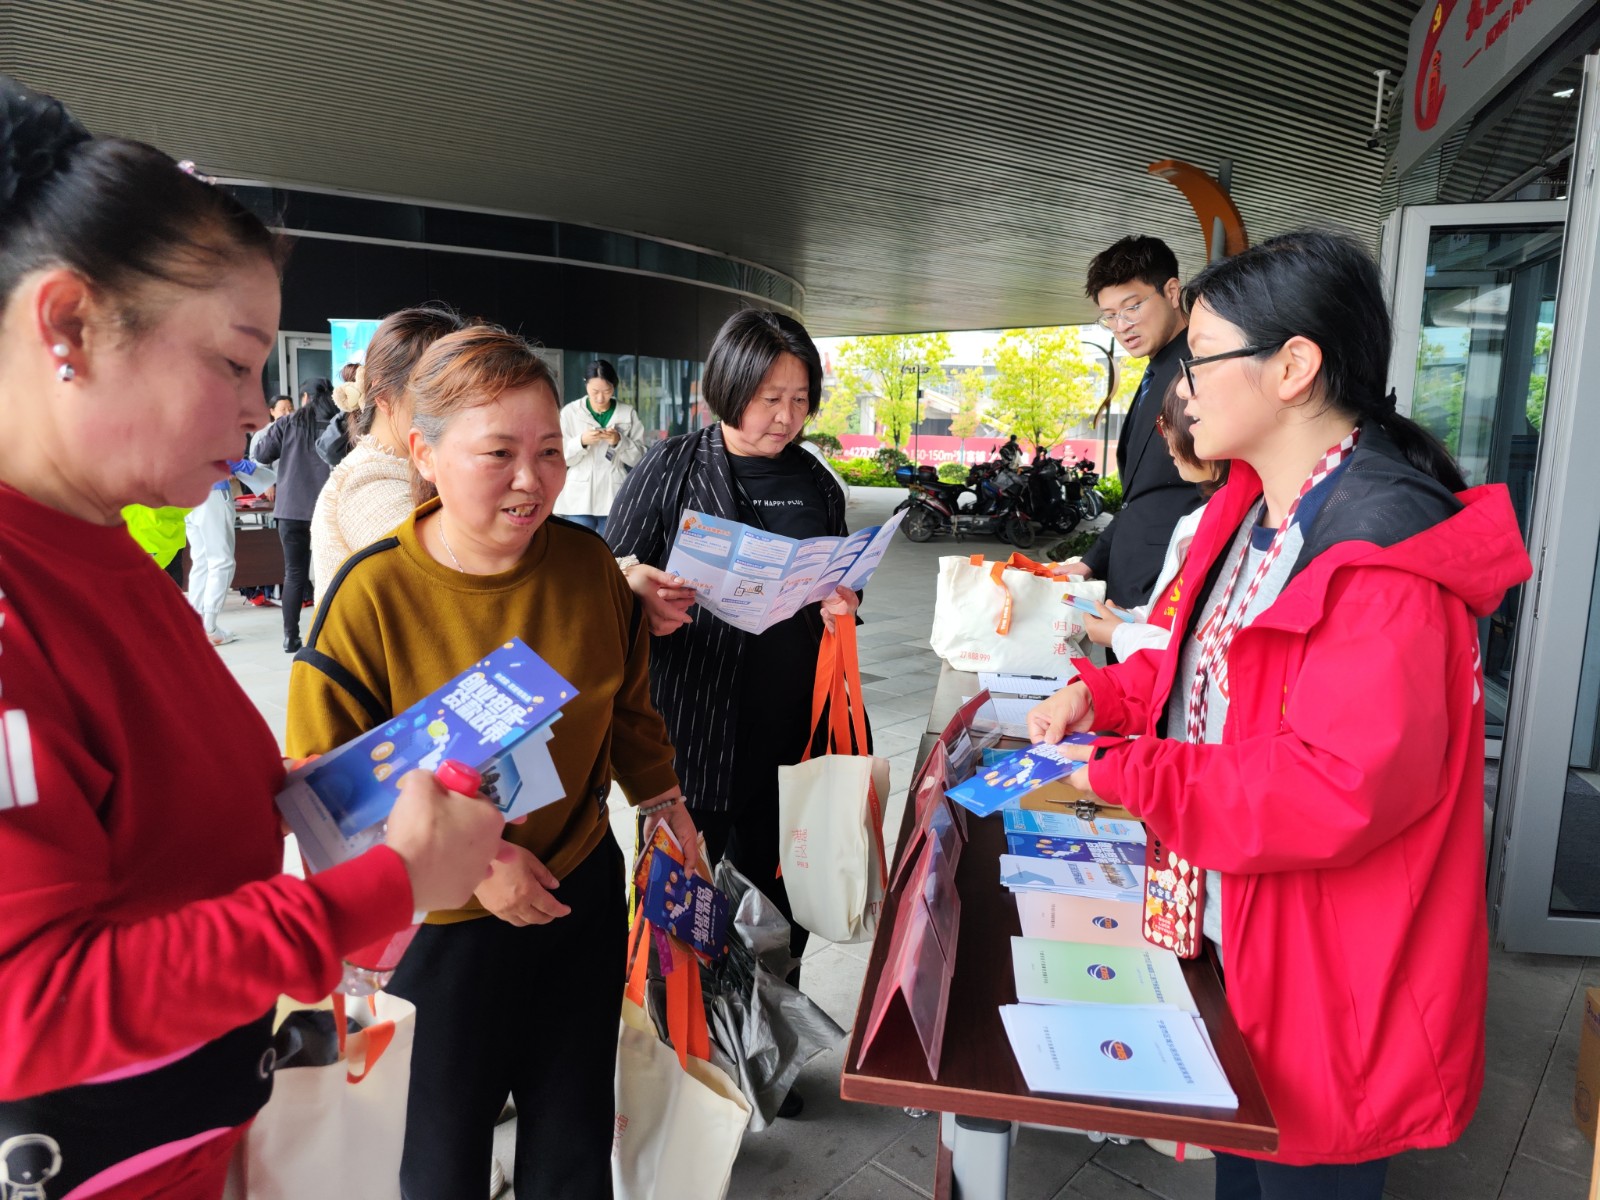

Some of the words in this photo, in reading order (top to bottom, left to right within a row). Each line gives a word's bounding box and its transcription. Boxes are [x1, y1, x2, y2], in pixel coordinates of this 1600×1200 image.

[441, 687, 513, 746] 贷款政策
[457, 671, 528, 726] 创业担保
